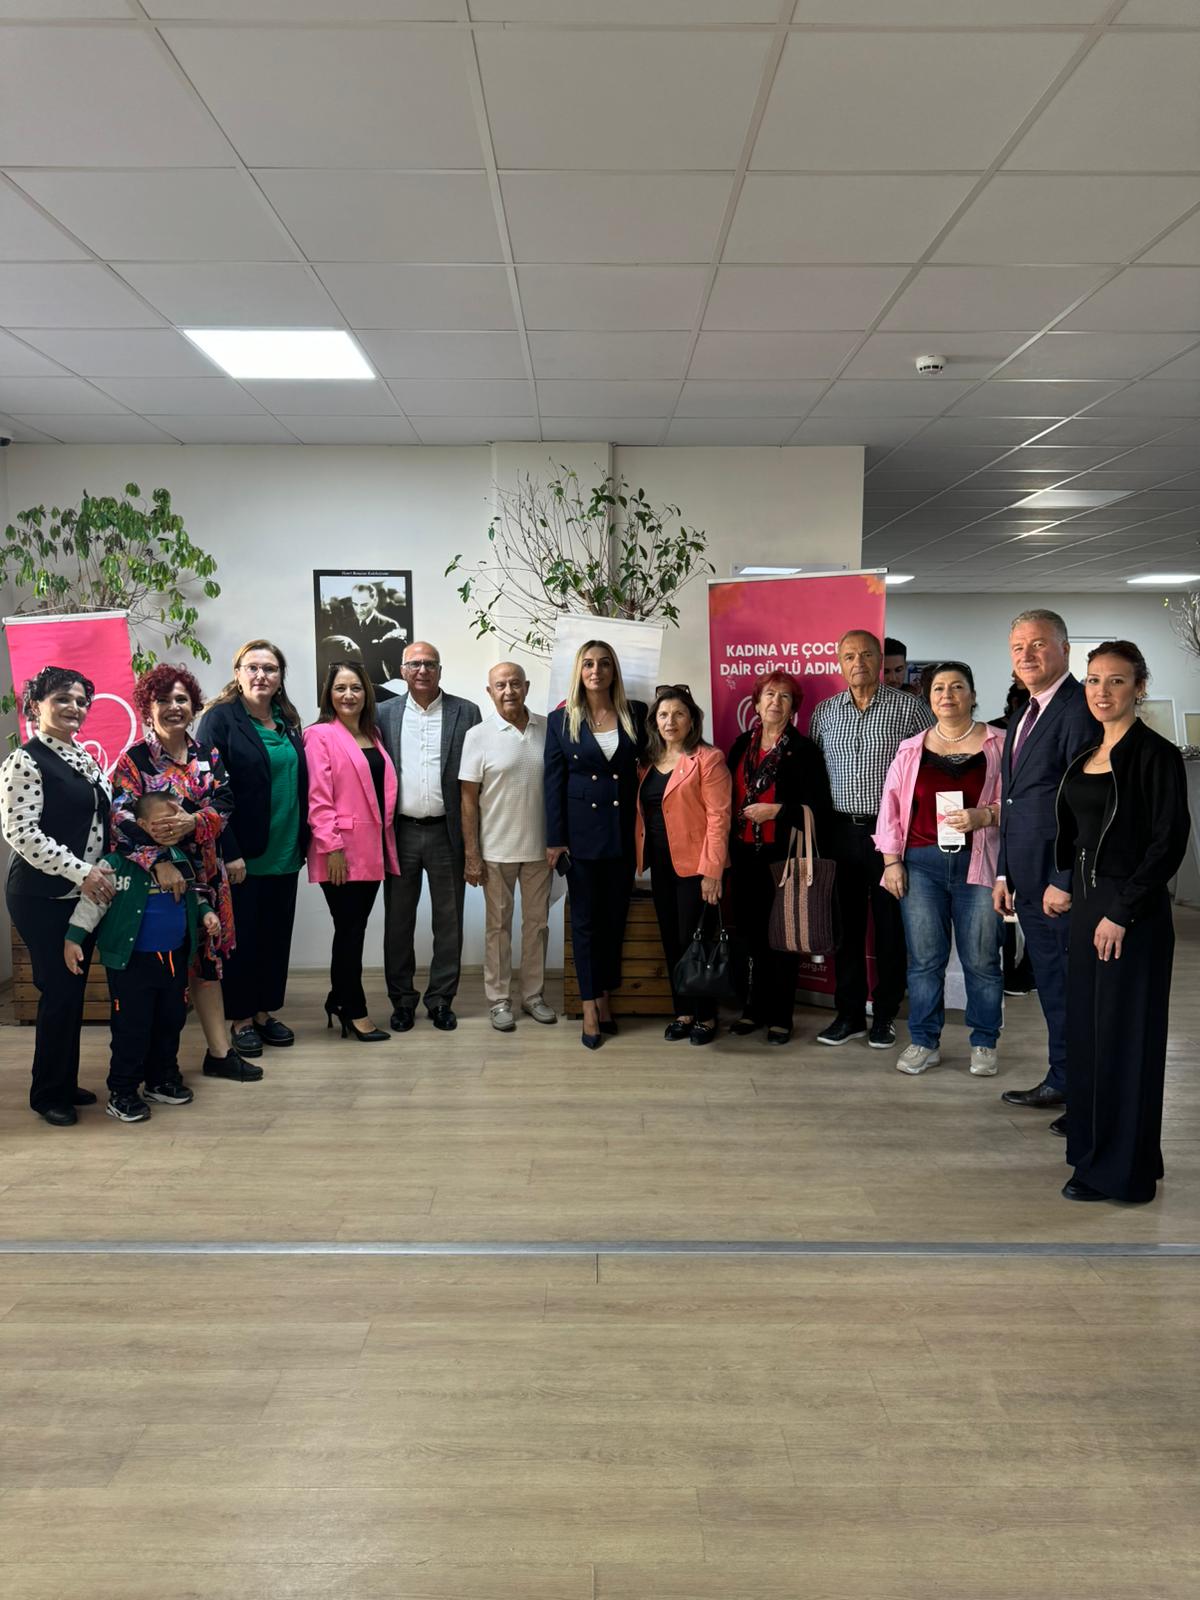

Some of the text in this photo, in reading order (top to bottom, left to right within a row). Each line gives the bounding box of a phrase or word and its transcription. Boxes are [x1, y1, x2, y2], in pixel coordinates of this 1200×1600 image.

[726, 641, 839, 659] KADINA VE ÇOC
[720, 661, 751, 676] DAİR
[804, 662, 843, 675] ADIM
[799, 962, 828, 973] .org.tr
